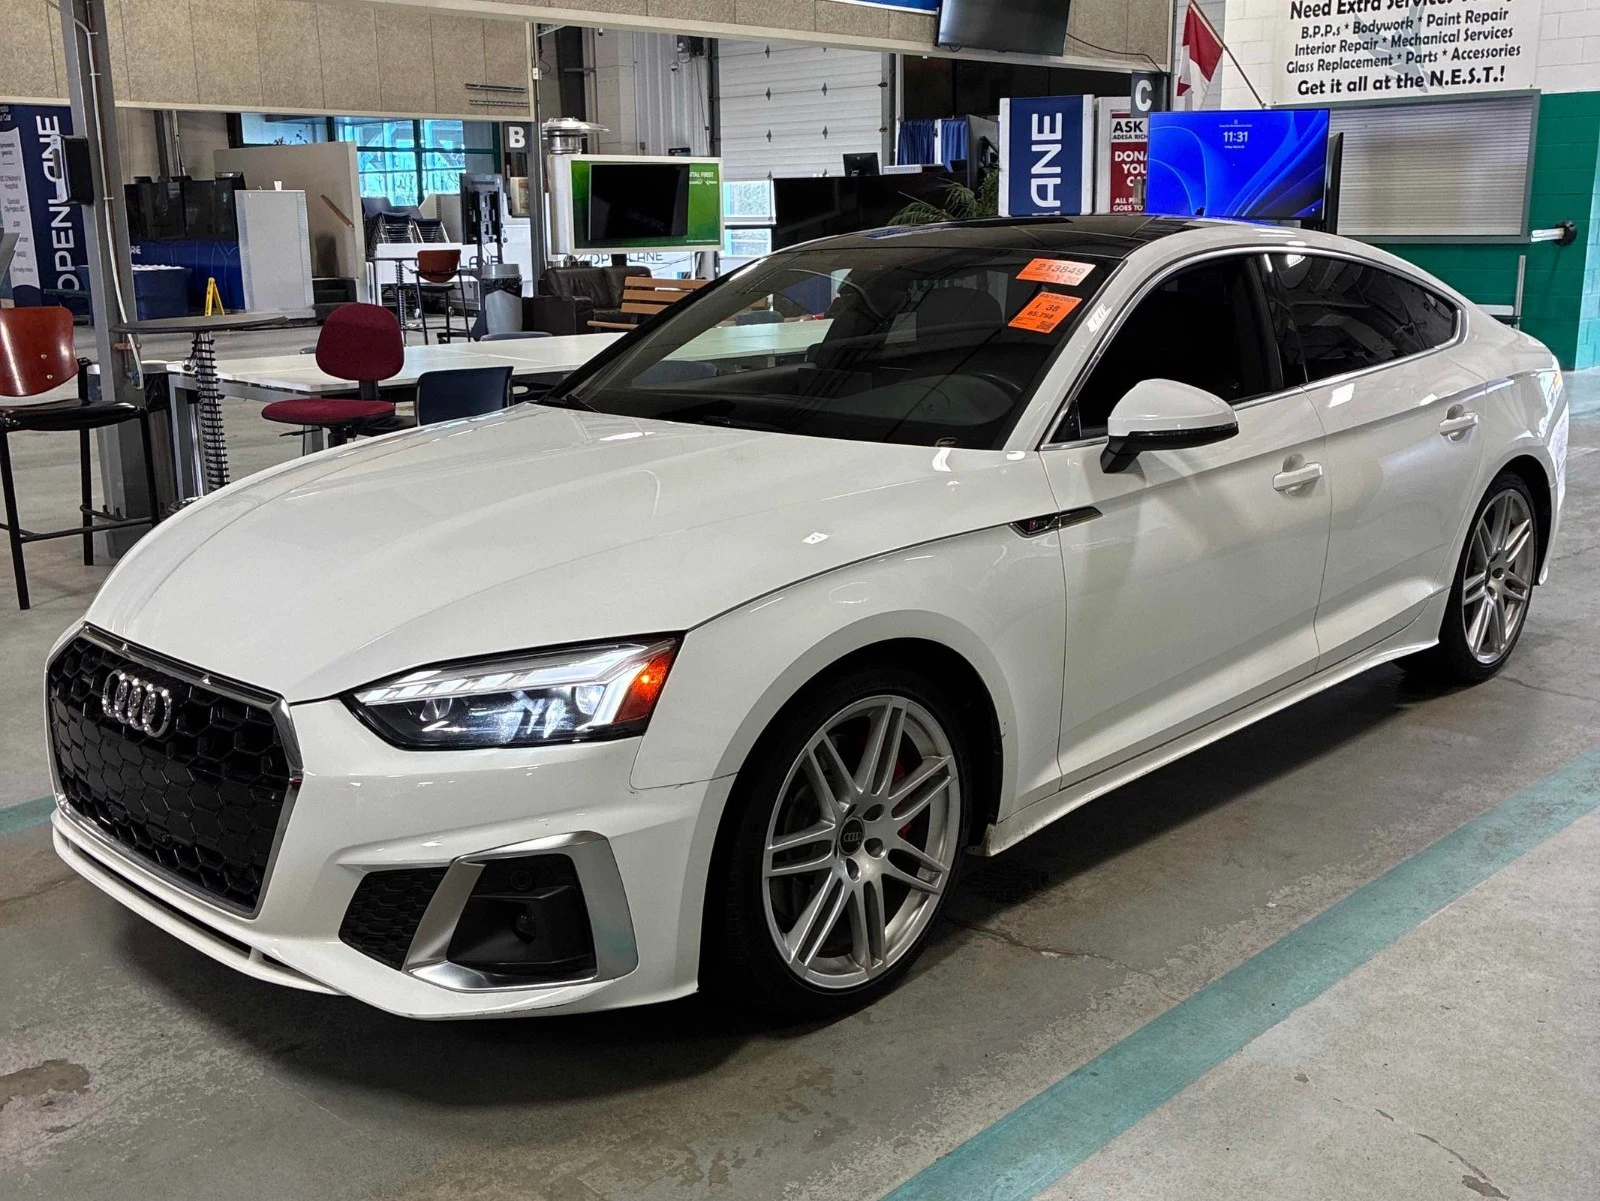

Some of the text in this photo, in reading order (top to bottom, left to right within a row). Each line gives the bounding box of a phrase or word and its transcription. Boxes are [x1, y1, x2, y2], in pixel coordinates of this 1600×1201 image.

[1290, 0, 1332, 20] Need
[1301, 7, 1509, 39] B.P.P.s Bodywork Paint Repair
[1295, 26, 1513, 56] Interior Repair Mechanical Services
[1286, 43, 1521, 74] Glass Replacement Parts Accessories
[1297, 65, 1505, 95] Get it all at the N.E.S.T.!
[1135, 80, 1152, 111] C
[509, 127, 525, 148] B
[1113, 121, 1143, 133] ASK
[1223, 131, 1248, 142] 11:31
[1035, 263, 1086, 275] 213849
